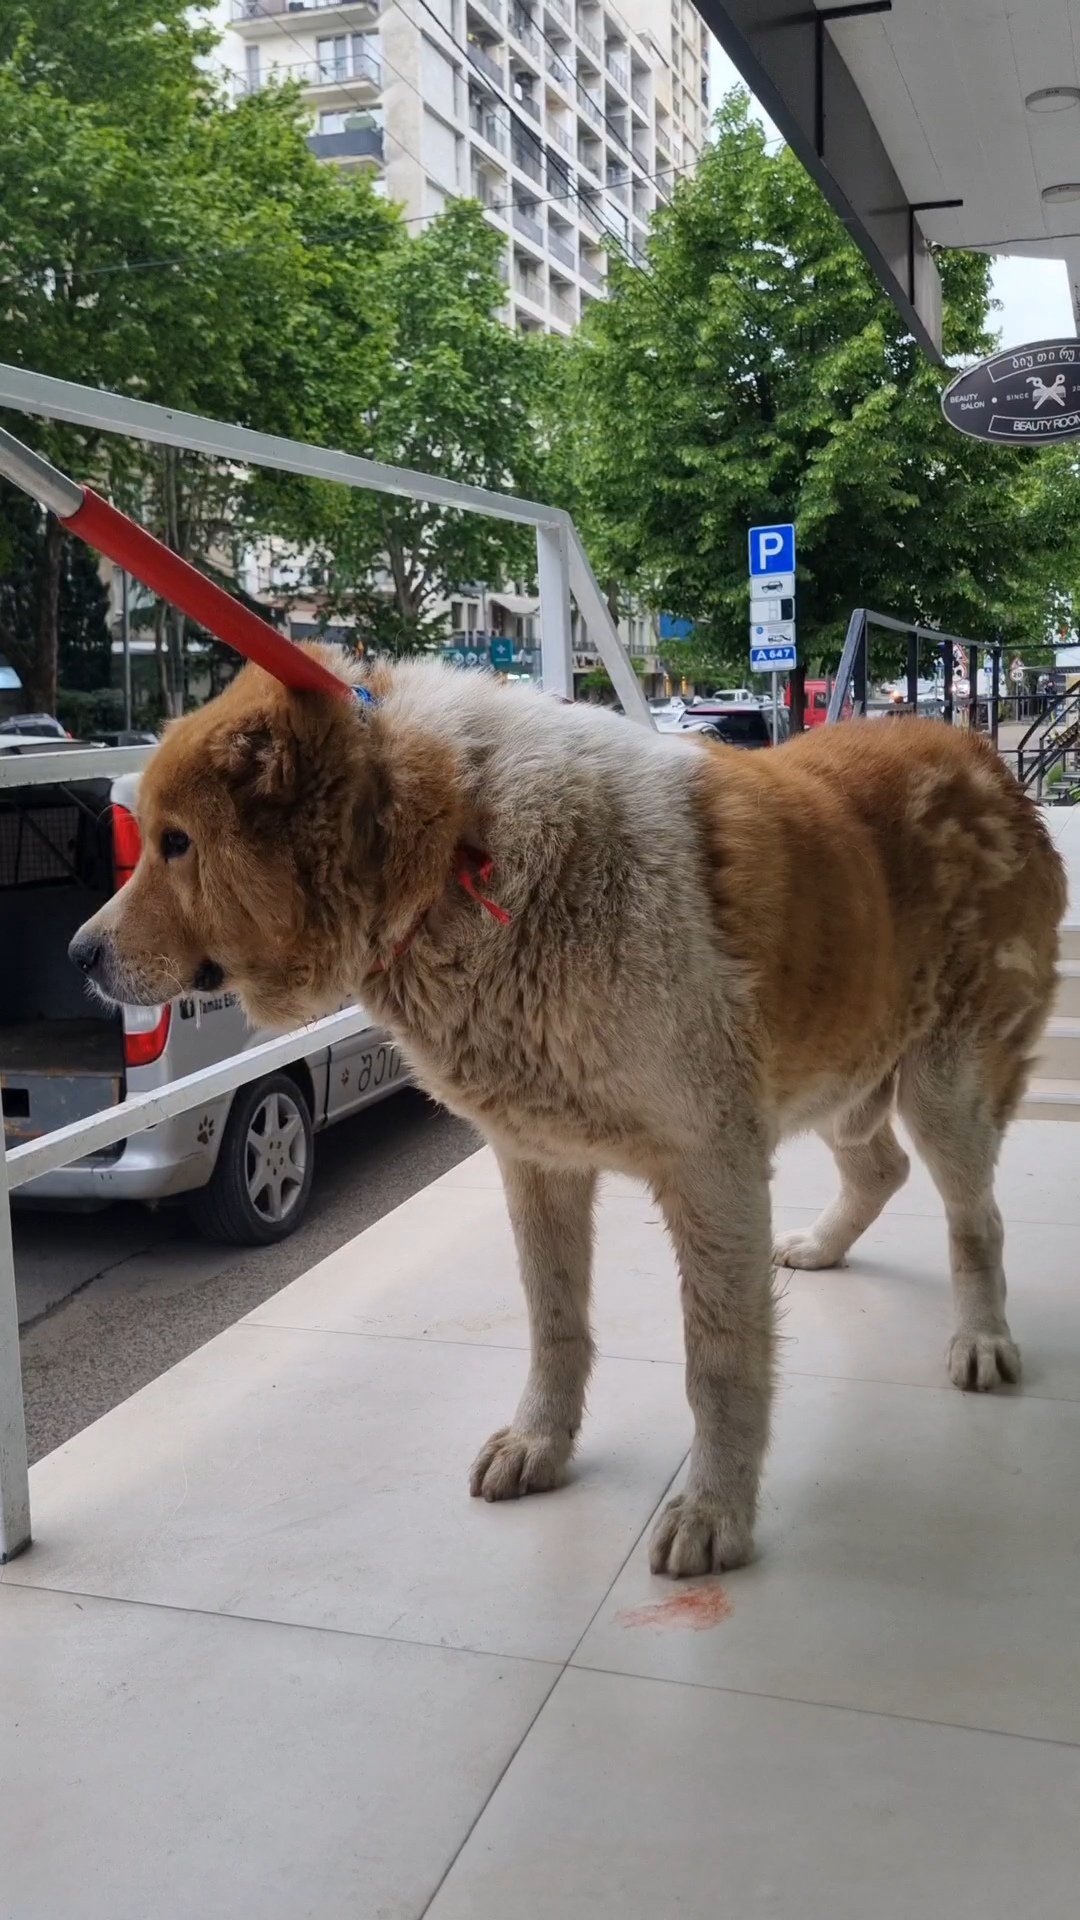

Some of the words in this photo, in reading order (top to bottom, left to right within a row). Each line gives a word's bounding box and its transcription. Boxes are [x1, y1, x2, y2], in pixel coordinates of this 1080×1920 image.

[950, 393, 979, 403] BEAUTY
[1006, 392, 1029, 401] SINCE
[960, 401, 985, 410] SALON
[1013, 419, 1053, 431] BEAUTY
[759, 532, 784, 570] P
[756, 650, 767, 661] A
[769, 649, 791, 658] 647
